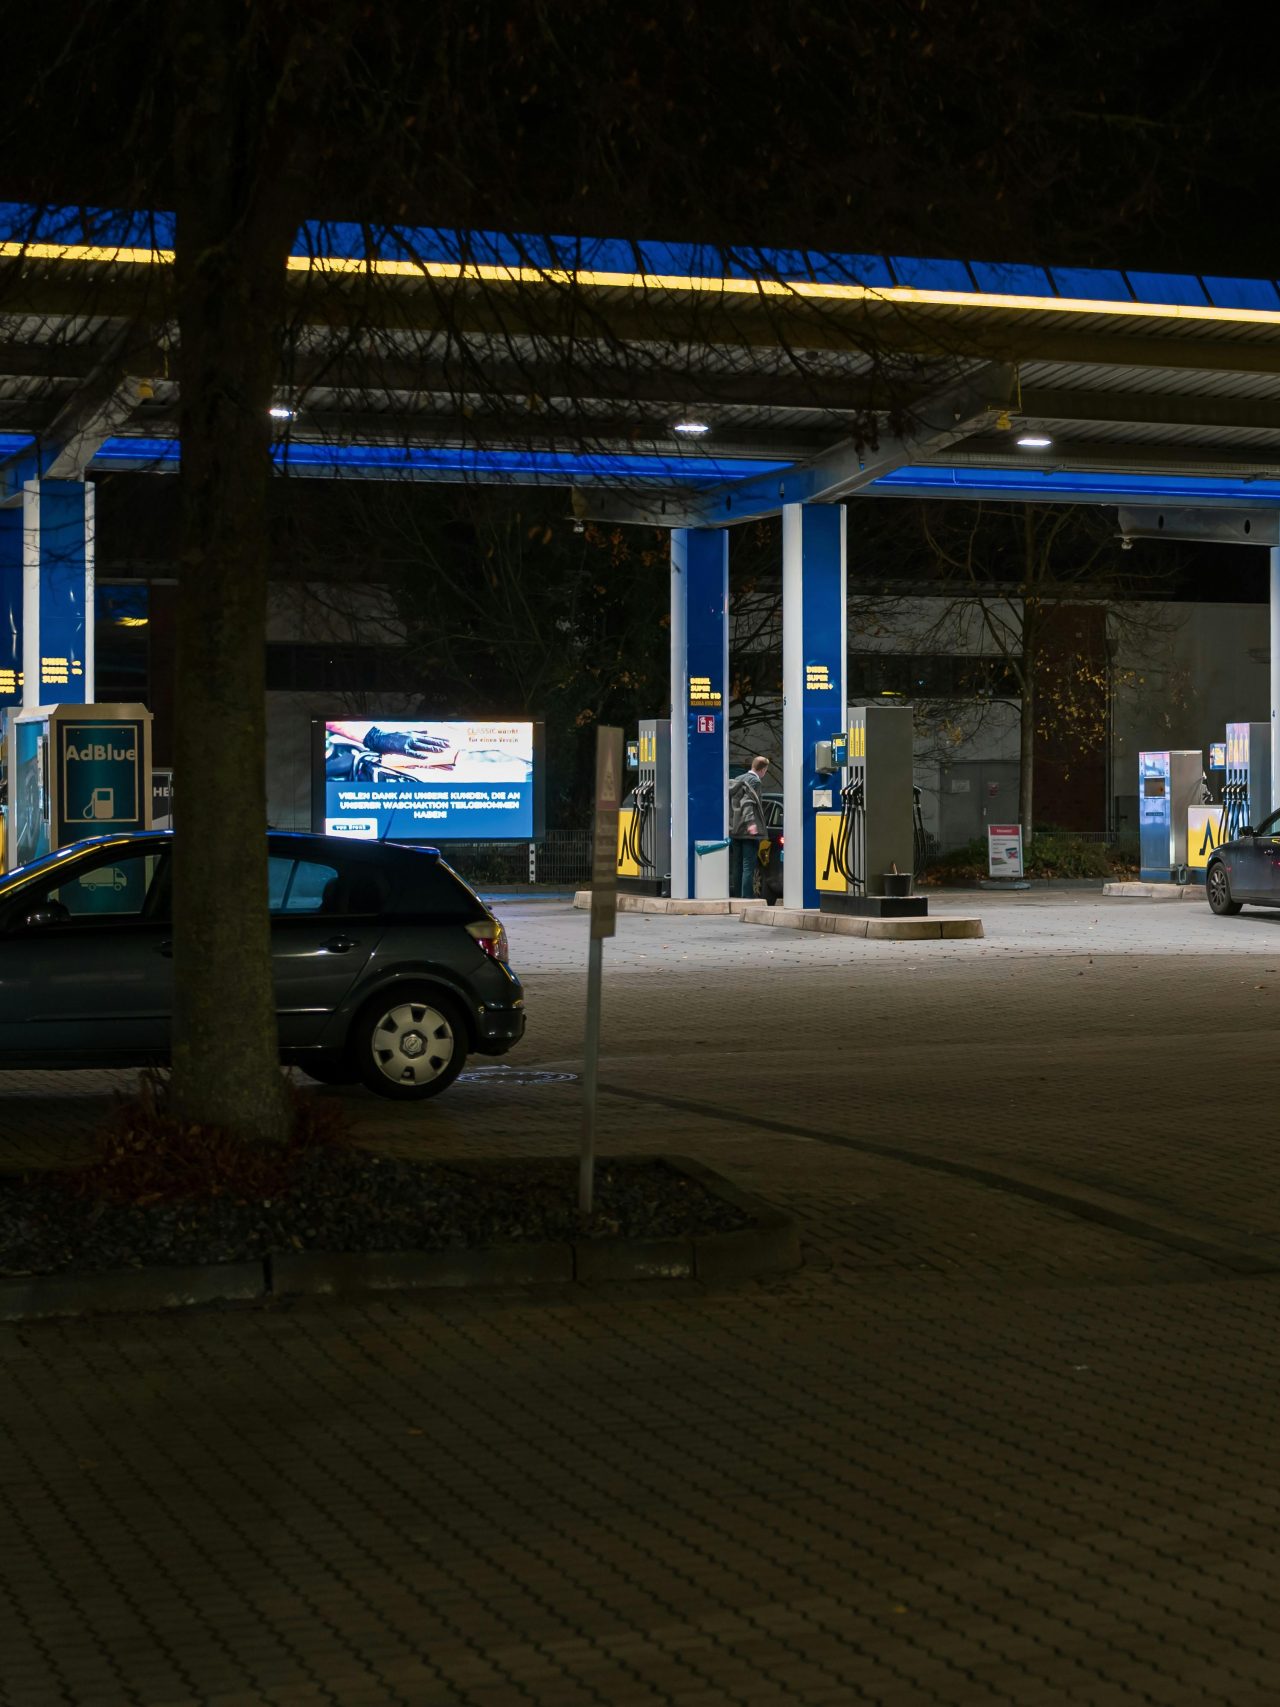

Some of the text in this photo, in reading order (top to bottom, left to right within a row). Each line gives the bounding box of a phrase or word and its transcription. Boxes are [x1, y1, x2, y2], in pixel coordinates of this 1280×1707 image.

[806, 674, 829, 682] SUPER
[690, 685, 711, 693] SUPER
[690, 692, 710, 700] SUPER
[66, 743, 137, 761] AdBlue
[338, 792, 371, 800] VIELEN
[372, 792, 398, 800] DANK
[398, 792, 413, 800] AN
[414, 792, 449, 800] UNSERE
[491, 792, 506, 800] DIE
[507, 792, 521, 800] AN
[339, 801, 520, 810] UNSERER WASCHAKTION TEILGENOMMEN
